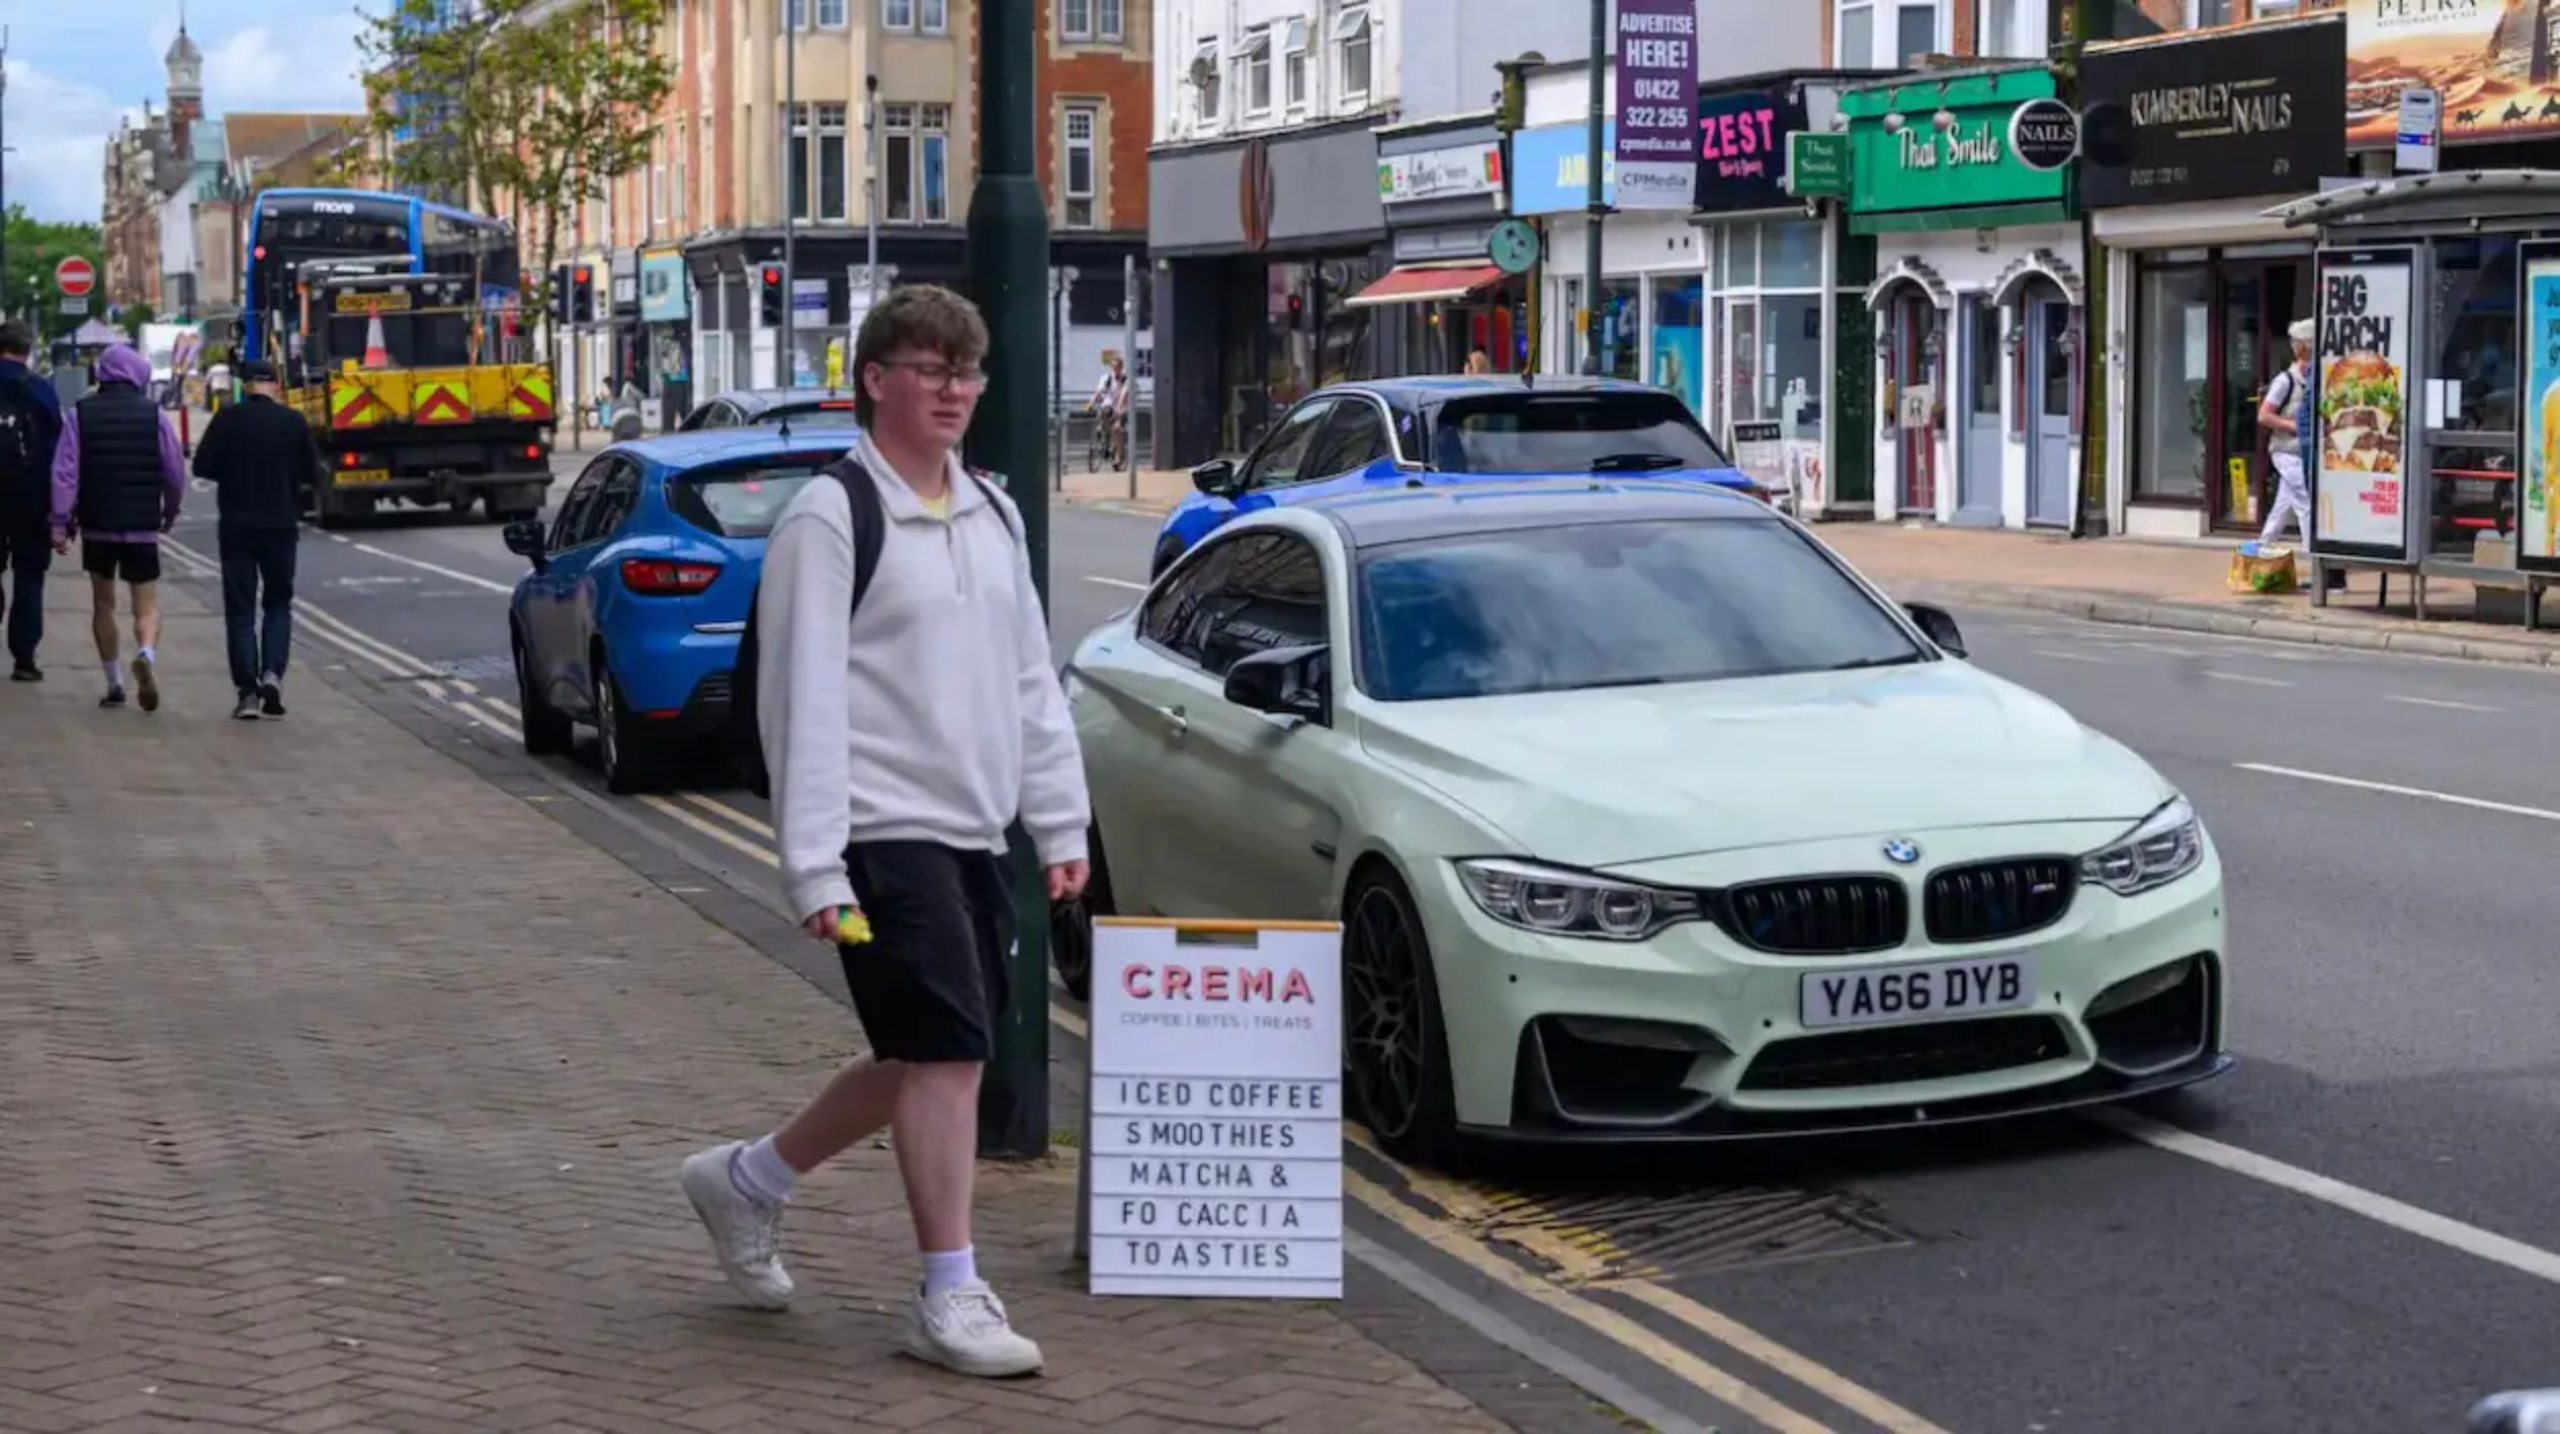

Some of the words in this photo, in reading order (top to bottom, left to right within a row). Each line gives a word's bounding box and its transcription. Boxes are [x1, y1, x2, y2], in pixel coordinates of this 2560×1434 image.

[1620, 13, 1694, 34] ADVERTISE
[1626, 39, 1688, 68] HERE!
[1634, 79, 1680, 100] 01422
[1626, 106, 1655, 128] 322
[1658, 107, 1688, 128] 255
[2131, 83, 2232, 127] KIMBERLEY
[2232, 93, 2292, 134] NAILS
[1620, 137, 1692, 152] cpmedia.co.uk
[1700, 108, 1774, 160] ZEST
[1896, 127, 1937, 169] Thai
[1946, 121, 2000, 165] Smile
[2019, 124, 2077, 142] NAILS
[1622, 173, 1687, 188] CPMedia
[313, 201, 355, 214] more
[2327, 274, 2367, 316] BIG
[2320, 316, 2391, 357] ARCH
[1121, 963, 1315, 1004] CREMA
[1822, 972, 1931, 1017] YA66
[1945, 963, 2020, 1008] DYB
[1120, 1012, 1181, 1027] COFFEE
[1196, 1013, 1239, 1028] BITES
[1253, 1015, 1312, 1029] TREATS
[1121, 1081, 1191, 1106] ICED
[1209, 1083, 1323, 1109] COFFEE
[1127, 1122, 1294, 1147] SMOOTHIES
[1130, 1162, 1252, 1187] MATCHA
[1270, 1164, 1288, 1187] &
[1127, 1242, 1289, 1267] TOASTIES
